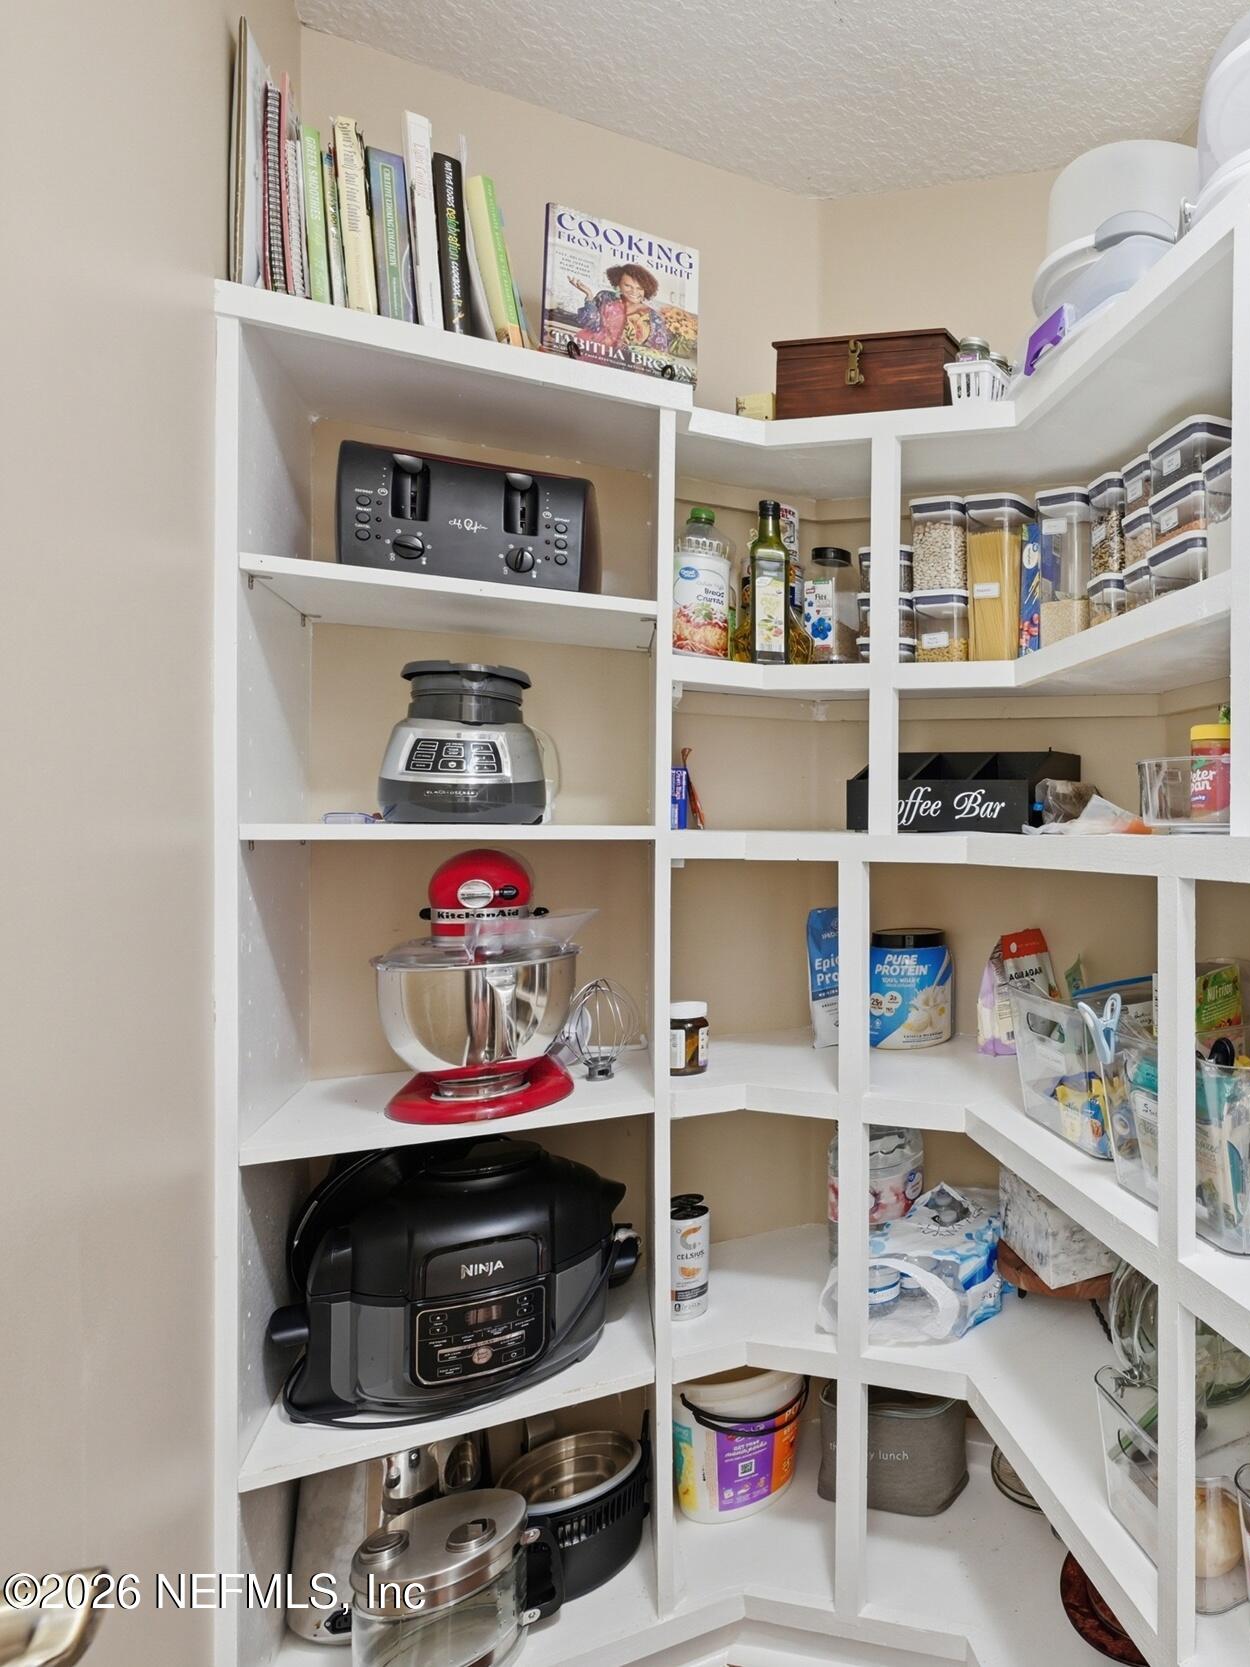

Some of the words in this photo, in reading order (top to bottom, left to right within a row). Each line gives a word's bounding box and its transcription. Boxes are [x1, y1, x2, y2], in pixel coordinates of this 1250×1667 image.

[306, 136, 319, 173] GREEN
[309, 172, 323, 221] SMOOTHIES
[556, 212, 694, 270] COOKING
[557, 230, 602, 253] FROM
[610, 247, 639, 263] THE
[646, 259, 693, 280] SPIRIT
[552, 328, 626, 361] TABITHA
[704, 588, 725, 598] Bread
[1191, 768, 1217, 780] eter
[953, 789, 1006, 821] Bar
[436, 908, 520, 921] KitchenAid
[884, 954, 918, 965] PURE
[874, 963, 928, 977] PROTEIN
[676, 1249, 705, 1261] CELSIUS
[460, 1258, 505, 1281] NINJA
[878, 1448, 910, 1462] lunch
